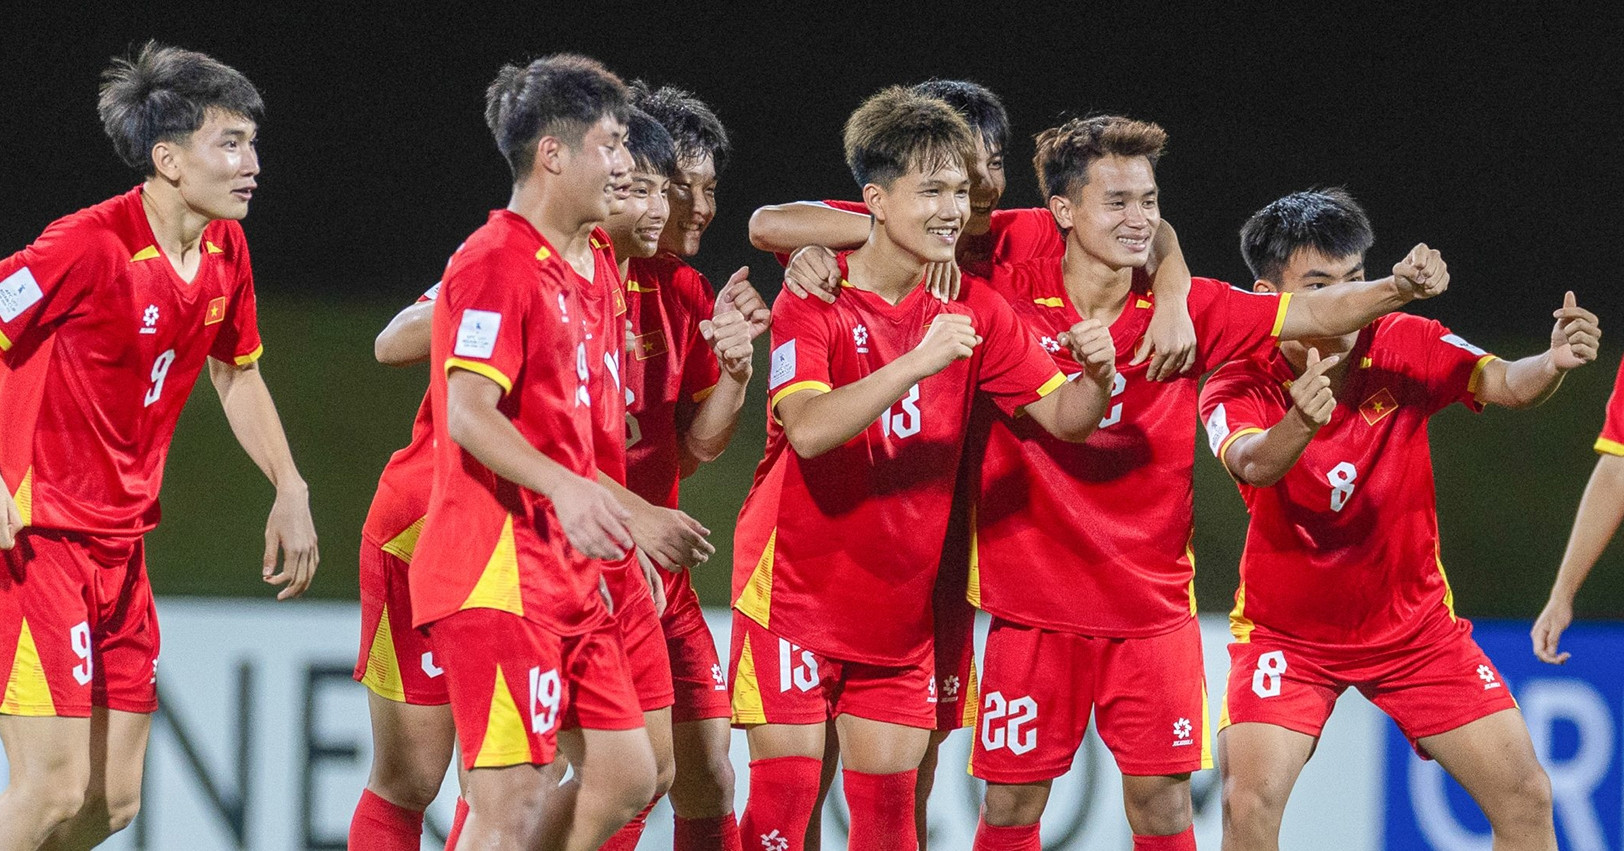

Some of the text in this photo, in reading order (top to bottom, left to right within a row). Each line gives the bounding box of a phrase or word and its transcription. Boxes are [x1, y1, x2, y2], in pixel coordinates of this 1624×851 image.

[144, 348, 176, 408] 9
[1327, 461, 1358, 513] 8
[70, 621, 94, 687] 9
[1251, 650, 1288, 699] 8
[529, 666, 562, 734] 19
[981, 690, 1038, 756] 22
